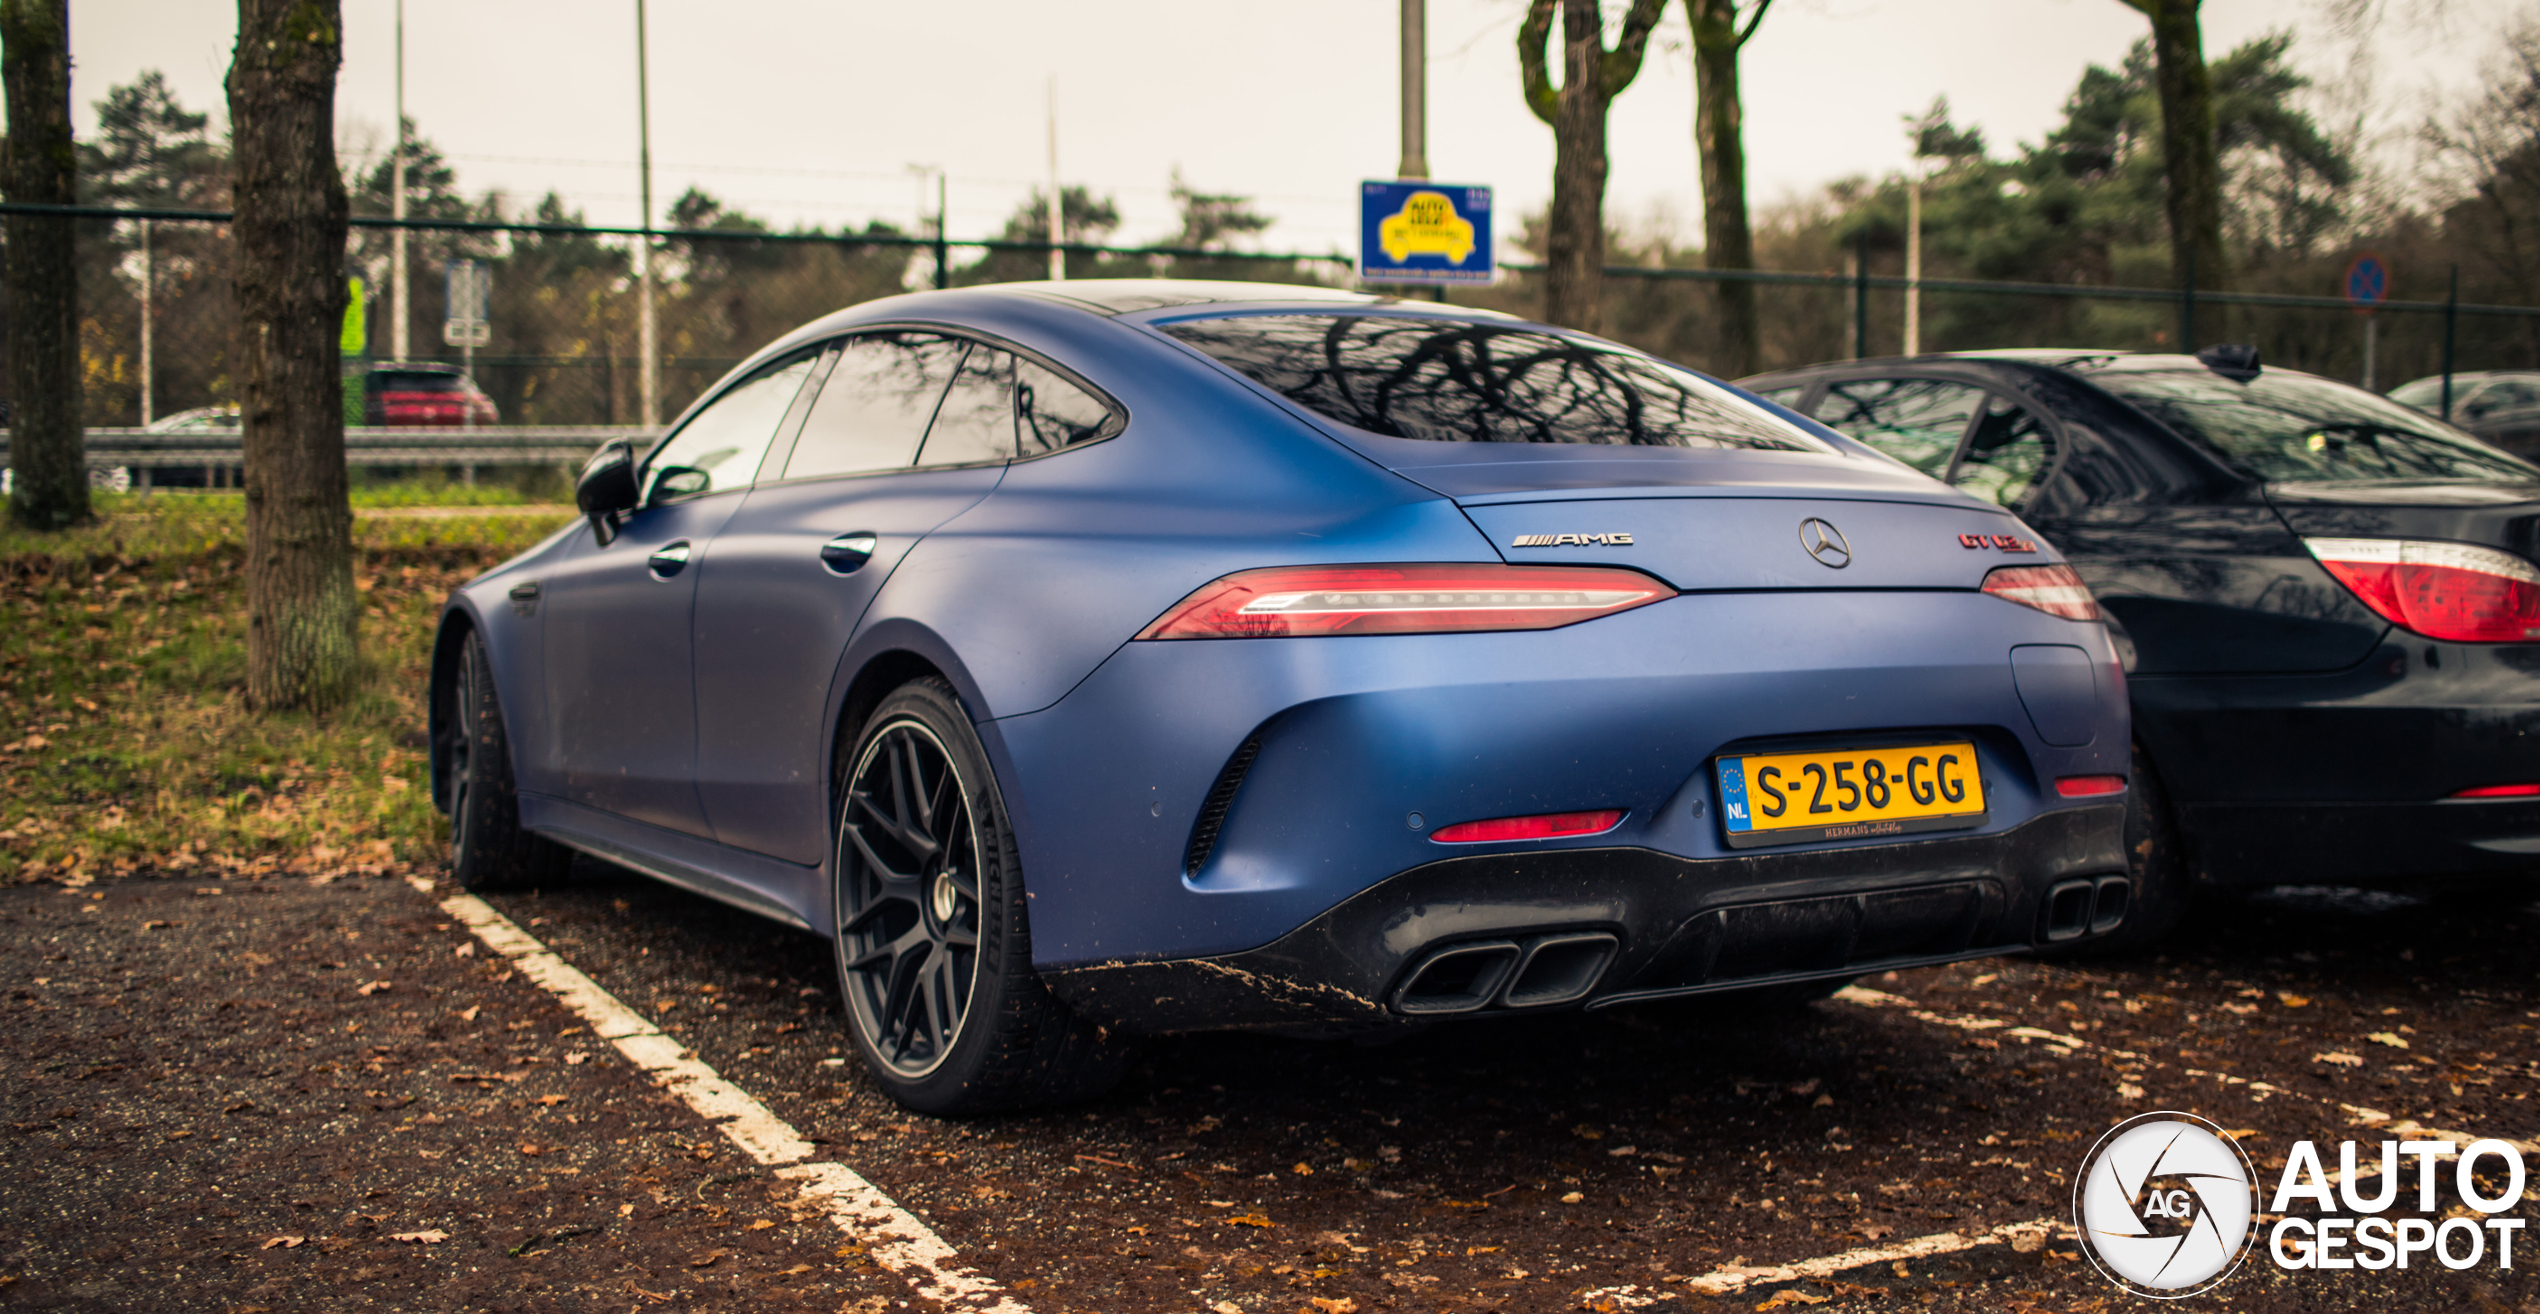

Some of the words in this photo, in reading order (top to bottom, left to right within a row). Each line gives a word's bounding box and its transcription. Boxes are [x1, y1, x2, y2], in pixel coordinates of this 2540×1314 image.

[1552, 533, 1634, 547] AMG
[1958, 533, 1989, 549] GT
[1757, 754, 1966, 817] S-258-GG
[1727, 802, 1748, 820] NL
[1825, 824, 1869, 837] HERMANS
[985, 826, 1001, 967] MICHELIN
